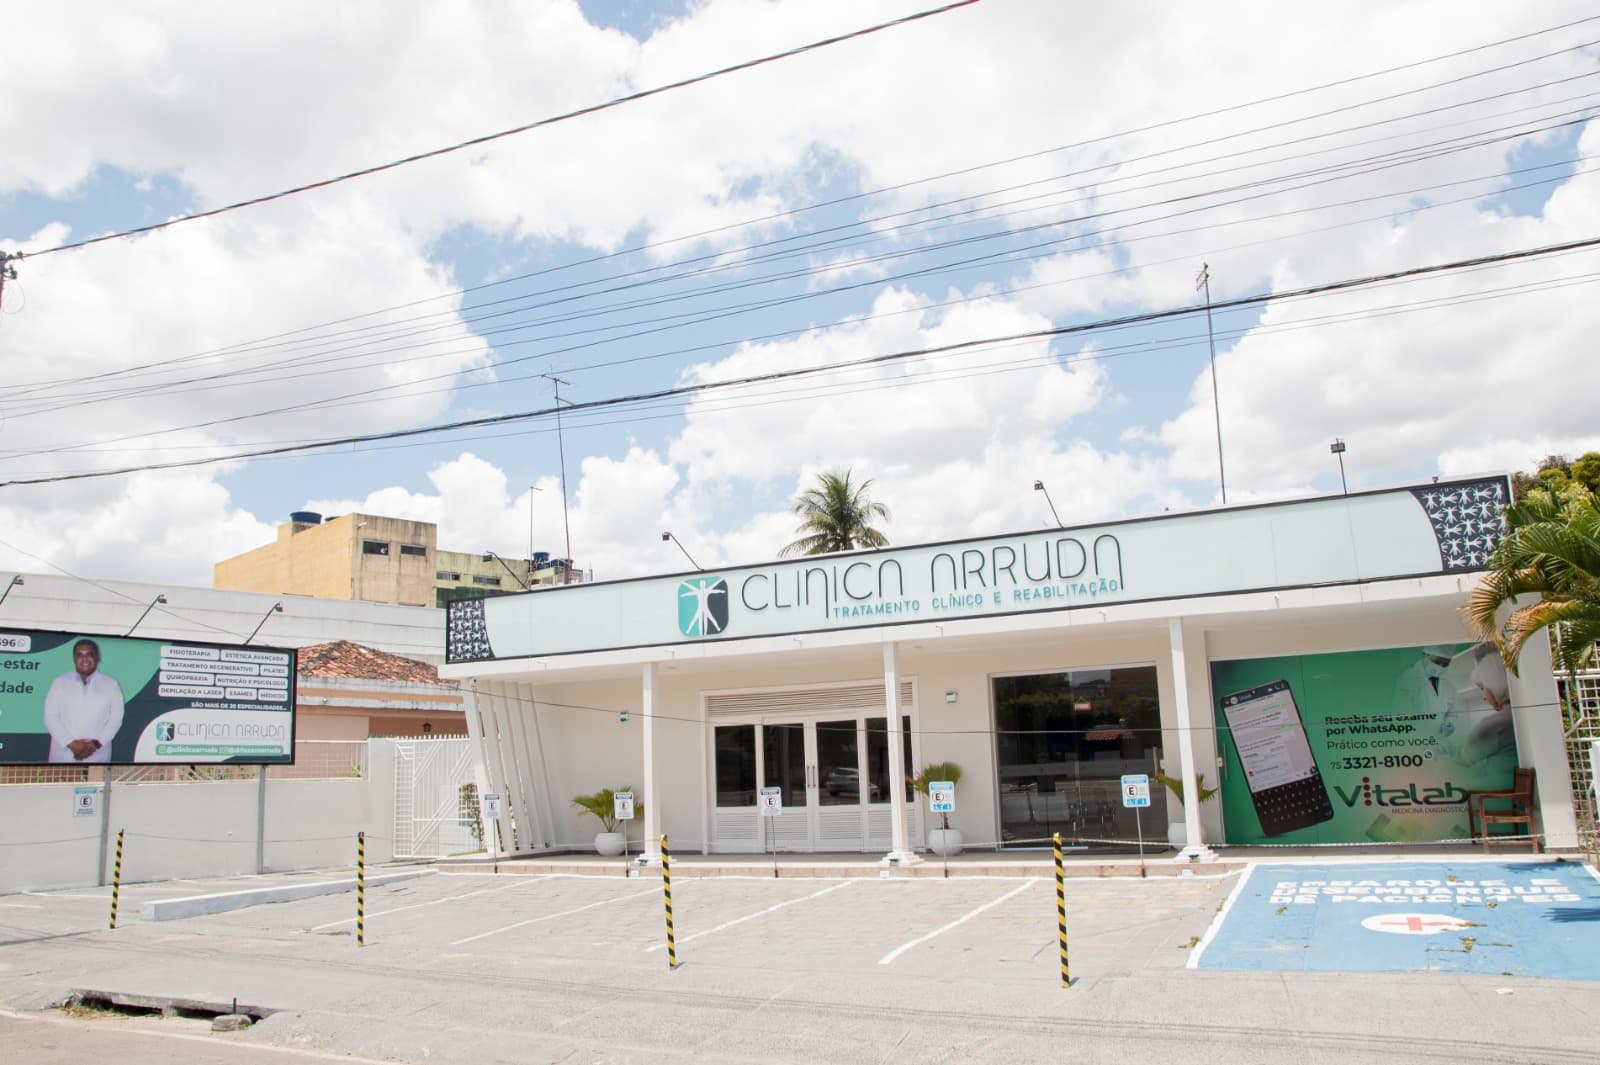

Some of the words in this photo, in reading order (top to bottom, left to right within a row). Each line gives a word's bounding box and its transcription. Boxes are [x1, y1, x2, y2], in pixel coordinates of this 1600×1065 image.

[833, 599, 920, 619] TRATAMENTO
[931, 592, 983, 609] CLÍNICO
[993, 591, 1001, 604] E
[1013, 577, 1119, 601] REABILITAÇÃO
[169, 649, 211, 657] FISIOTERAPIA
[167, 661, 209, 670] TRATAMENTO
[209, 664, 254, 673] REGENERATIVO
[166, 674, 208, 682] QUIROPRAXIA
[160, 687, 196, 696] DEPILAÇÃO
[1326, 727, 1346, 737] por
[1348, 724, 1416, 735] WhatsApp.
[1327, 740, 1368, 750] Prático
[1371, 740, 1405, 748] como
[1408, 736, 1439, 746] você.
[1330, 762, 1342, 770] 75
[1342, 755, 1423, 770] 3321-8100
[1530, 878, 1562, 886] E
[1271, 886, 1570, 896] DESEMBARQUE
[1269, 894, 1317, 904] DE
[1331, 894, 1583, 904] PACIENTES
